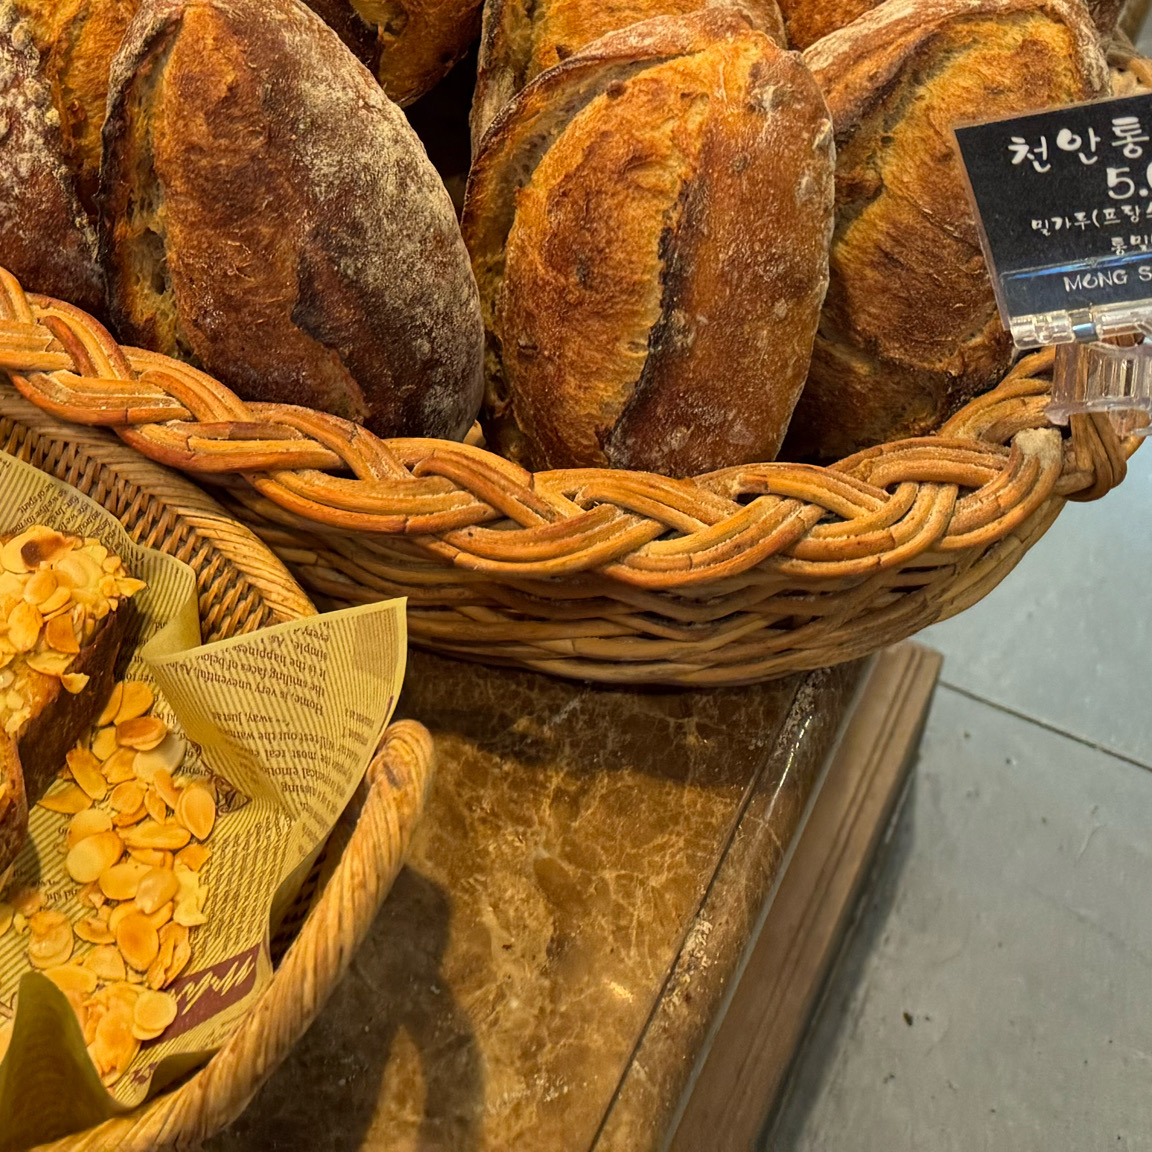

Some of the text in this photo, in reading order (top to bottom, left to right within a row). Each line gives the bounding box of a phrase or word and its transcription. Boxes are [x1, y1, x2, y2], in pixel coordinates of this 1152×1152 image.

[1106, 161, 1152, 199] 5.
[1064, 269, 1128, 292] MONG
[255, 682, 277, 697] very
